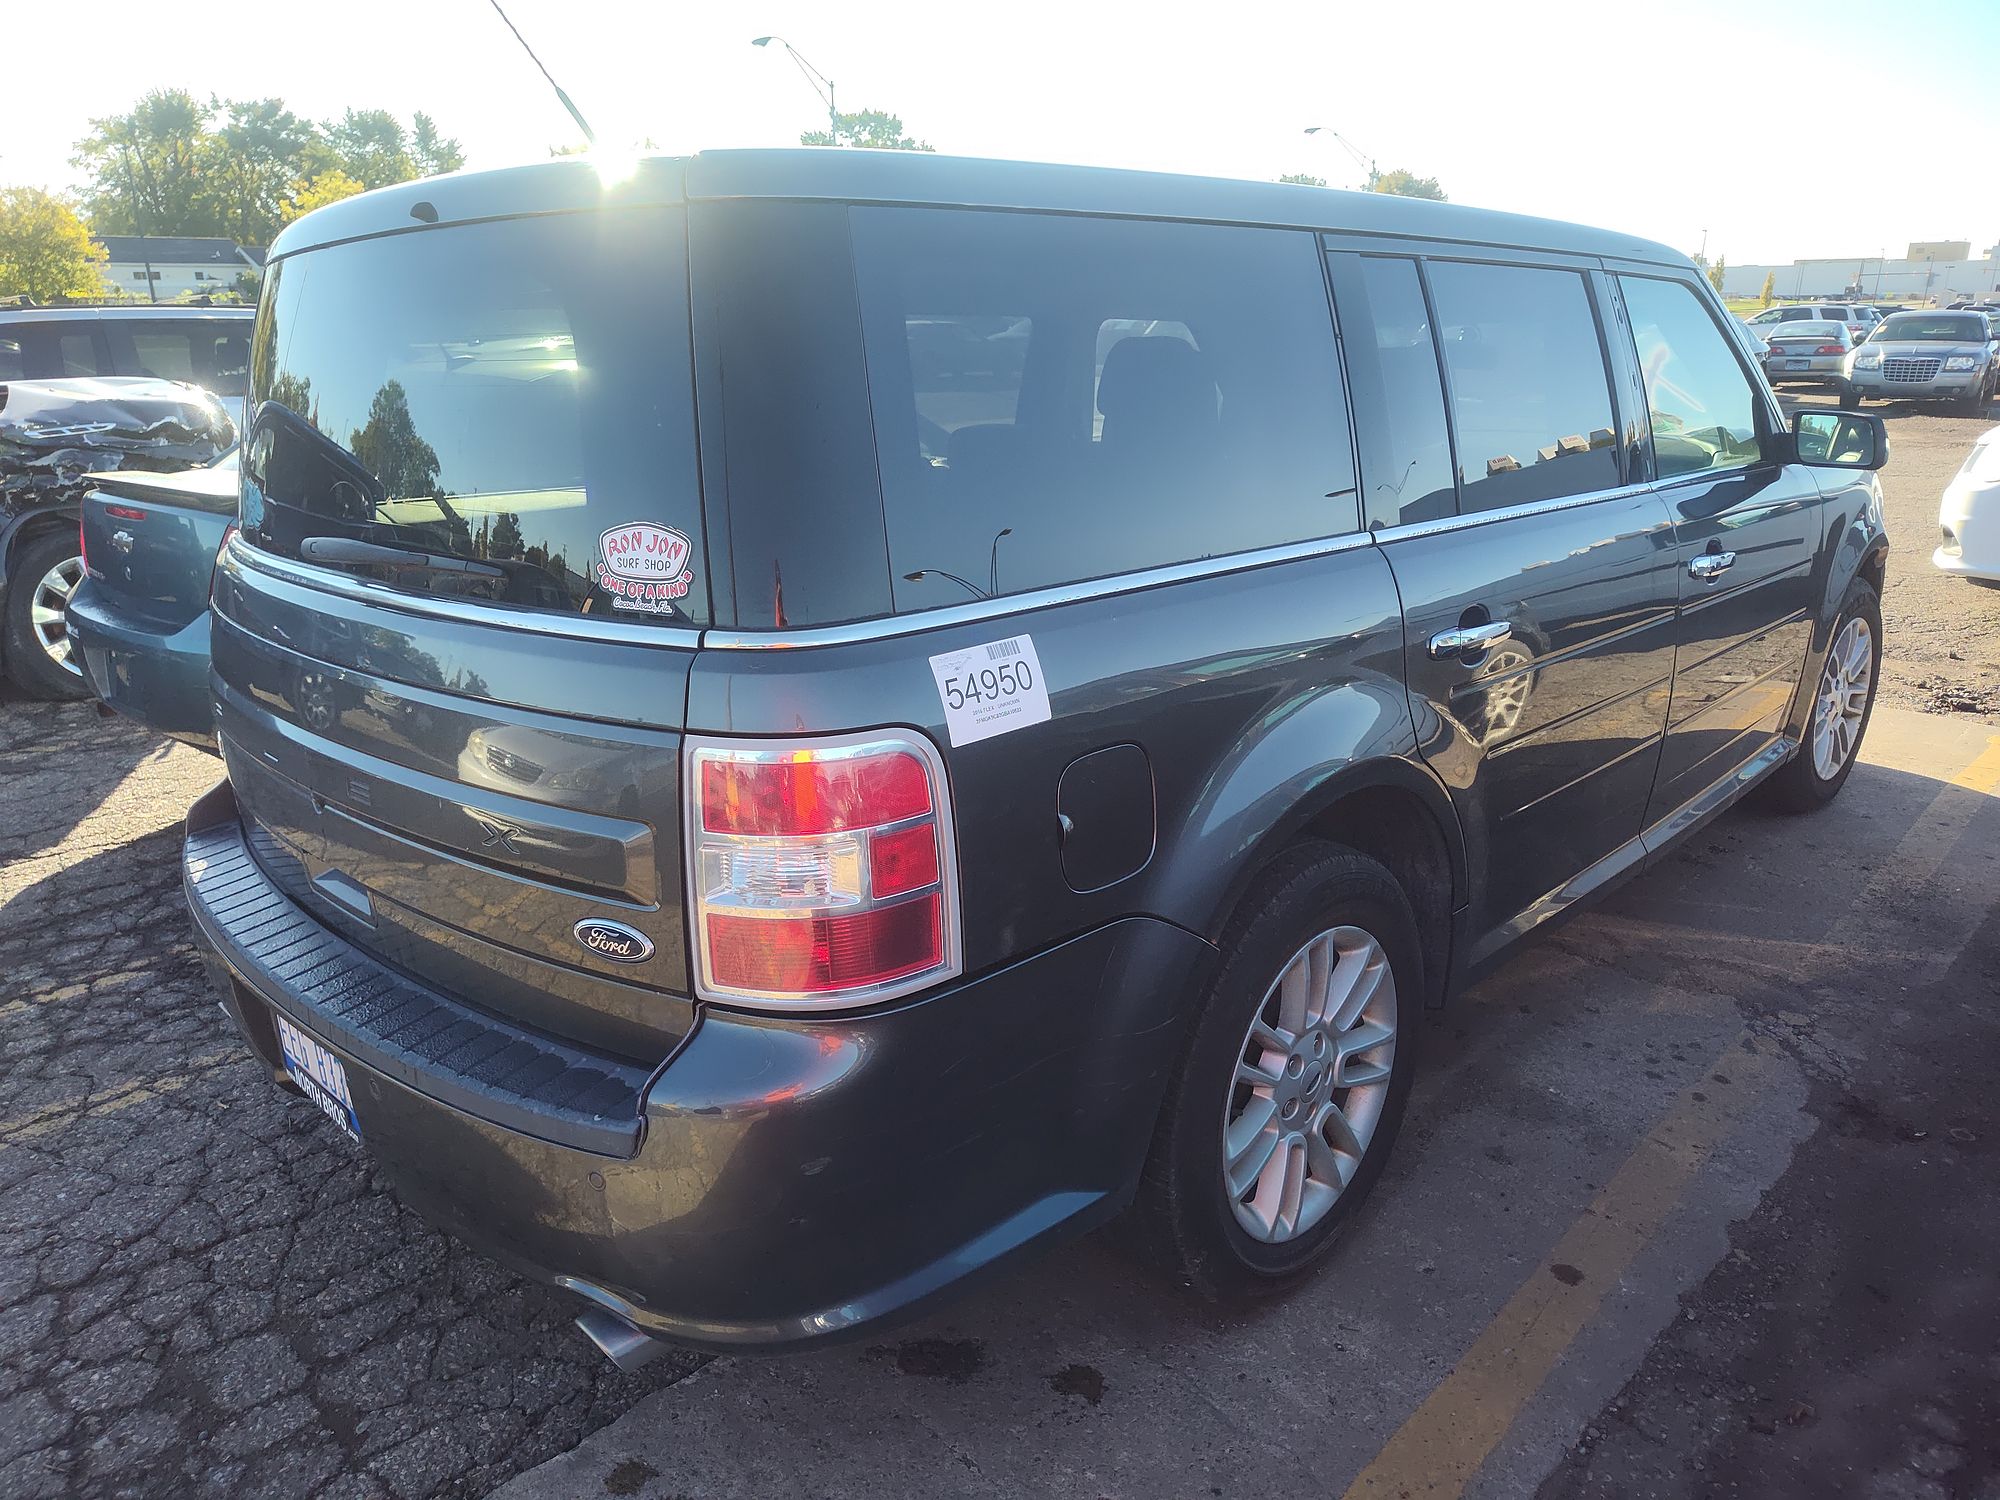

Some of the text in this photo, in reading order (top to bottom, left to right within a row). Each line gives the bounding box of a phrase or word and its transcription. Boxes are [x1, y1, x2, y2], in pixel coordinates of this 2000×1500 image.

[608, 532, 683, 560] RON JON
[617, 557, 671, 572] SURF SHOP
[627, 582, 645, 599] OF
[645, 584, 656, 600] A
[944, 660, 1033, 710] 54950
[587, 927, 631, 955] Ford
[293, 1066, 322, 1108] NORTH
[321, 1092, 347, 1131] BROS
